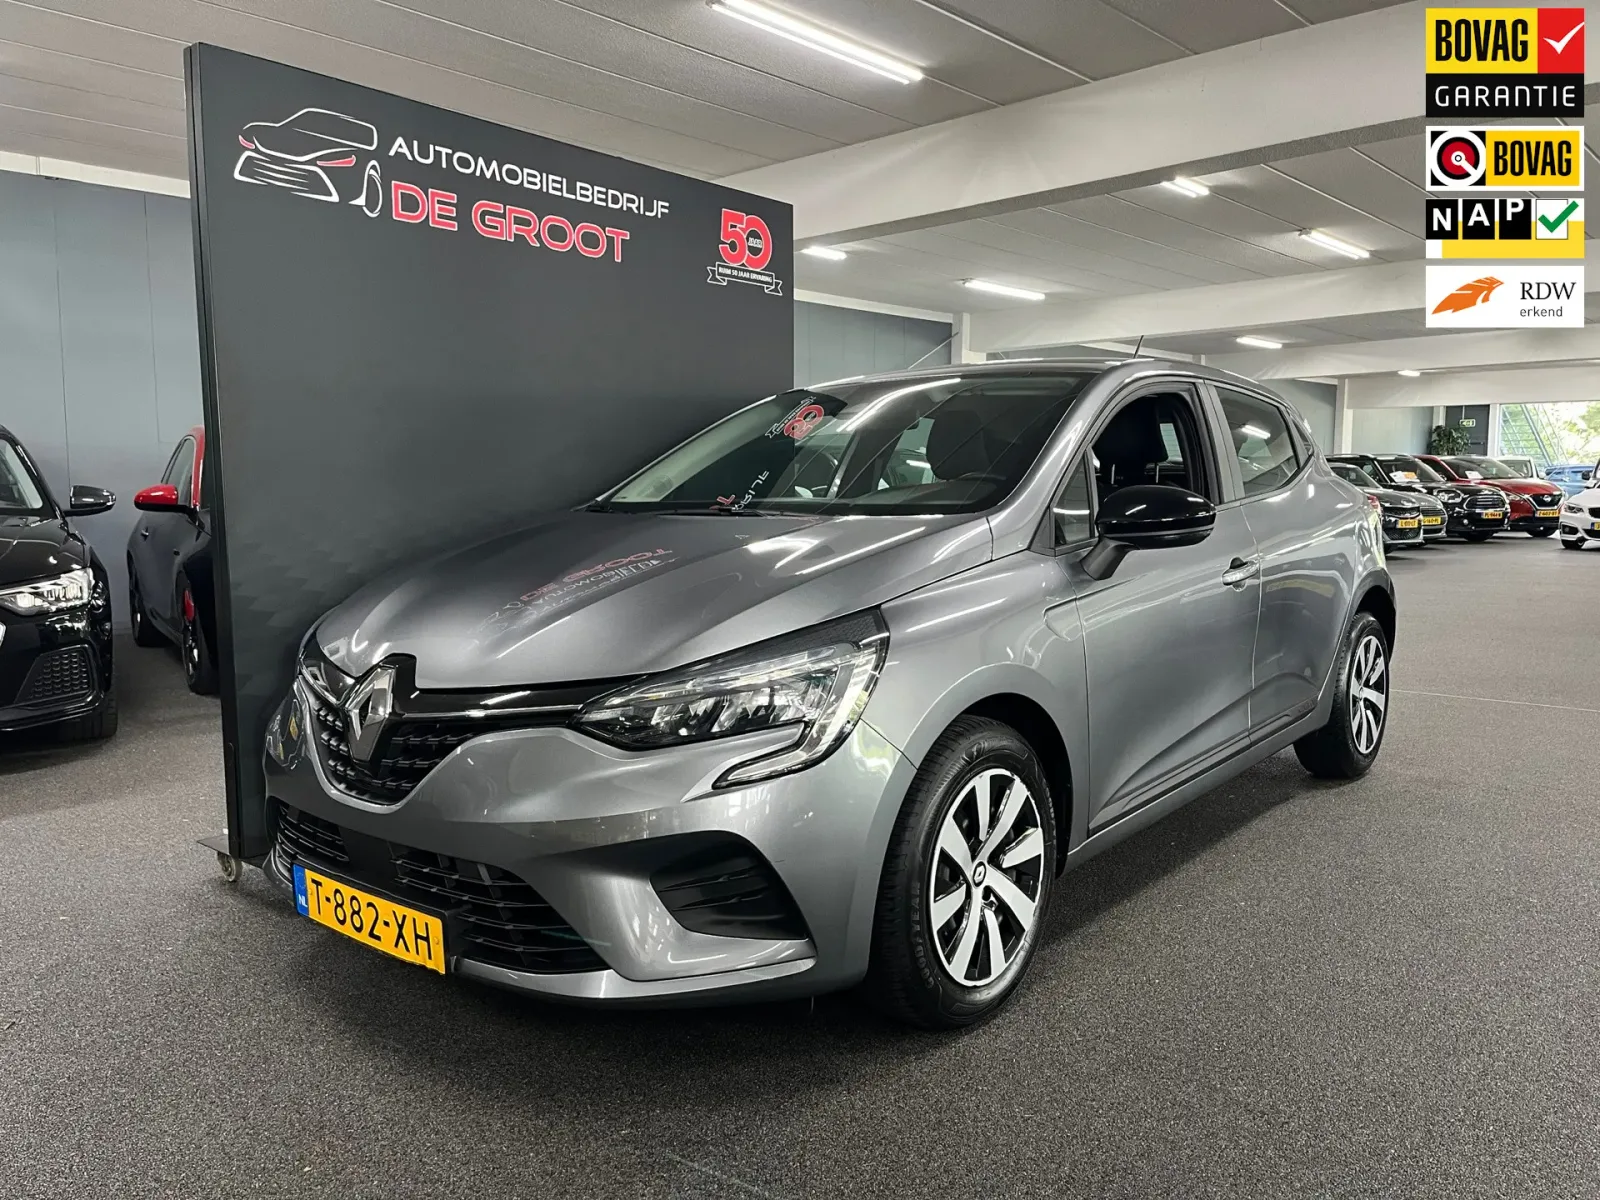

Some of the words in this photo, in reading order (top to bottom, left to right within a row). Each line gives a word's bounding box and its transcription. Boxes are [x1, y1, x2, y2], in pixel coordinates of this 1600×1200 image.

[388, 136, 670, 219] AUTOMOBIELBEDRIJF
[391, 180, 458, 231] DE
[471, 200, 630, 262] GROOT
[718, 208, 773, 271] 50
[738, 270, 750, 278] JAAR
[298, 894, 308, 907] NL
[311, 878, 433, 961] T-882-XH
